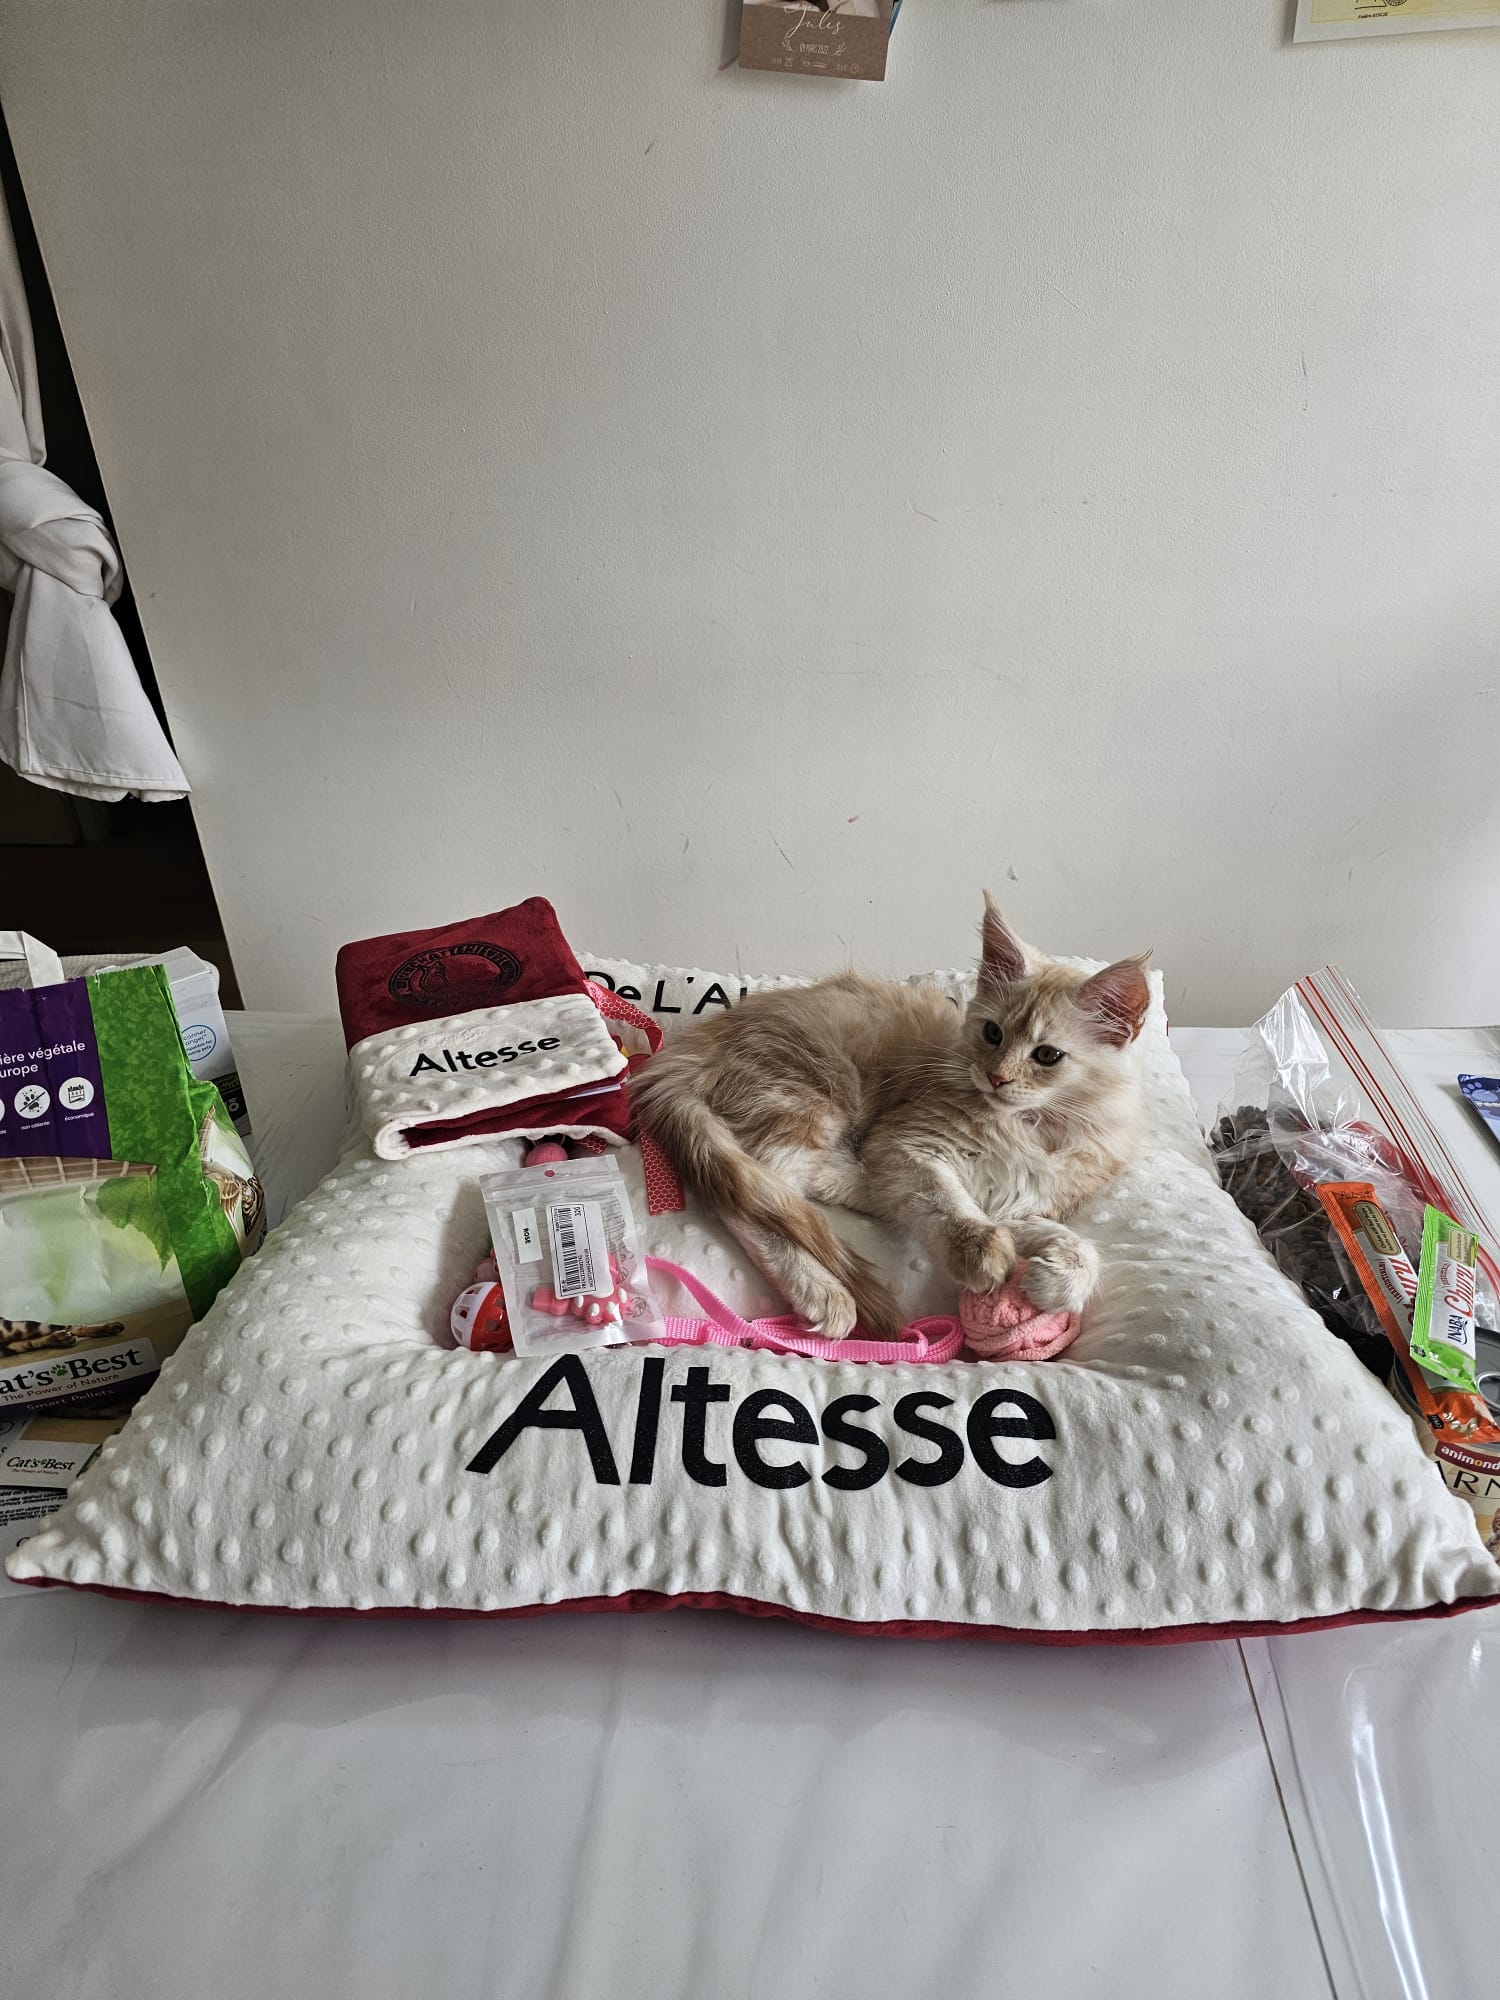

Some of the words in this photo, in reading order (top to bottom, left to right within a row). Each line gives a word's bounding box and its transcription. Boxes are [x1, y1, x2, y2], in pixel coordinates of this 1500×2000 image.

[653, 977, 748, 1014] L'A
[28, 1040, 86, 1062] végétale
[409, 1035, 561, 1077] Altesse
[523, 1227, 531, 1244] ROSE
[1448, 1315, 1462, 1342] INABA
[64, 1348, 144, 1380] Best
[2, 1393, 24, 1402] The
[27, 1386, 62, 1397] Power
[66, 1381, 77, 1389] of
[81, 1374, 119, 1386] Nature
[464, 1353, 1057, 1490] Altesse
[6, 1457, 40, 1468] Cat's
[43, 1458, 76, 1471] Best
